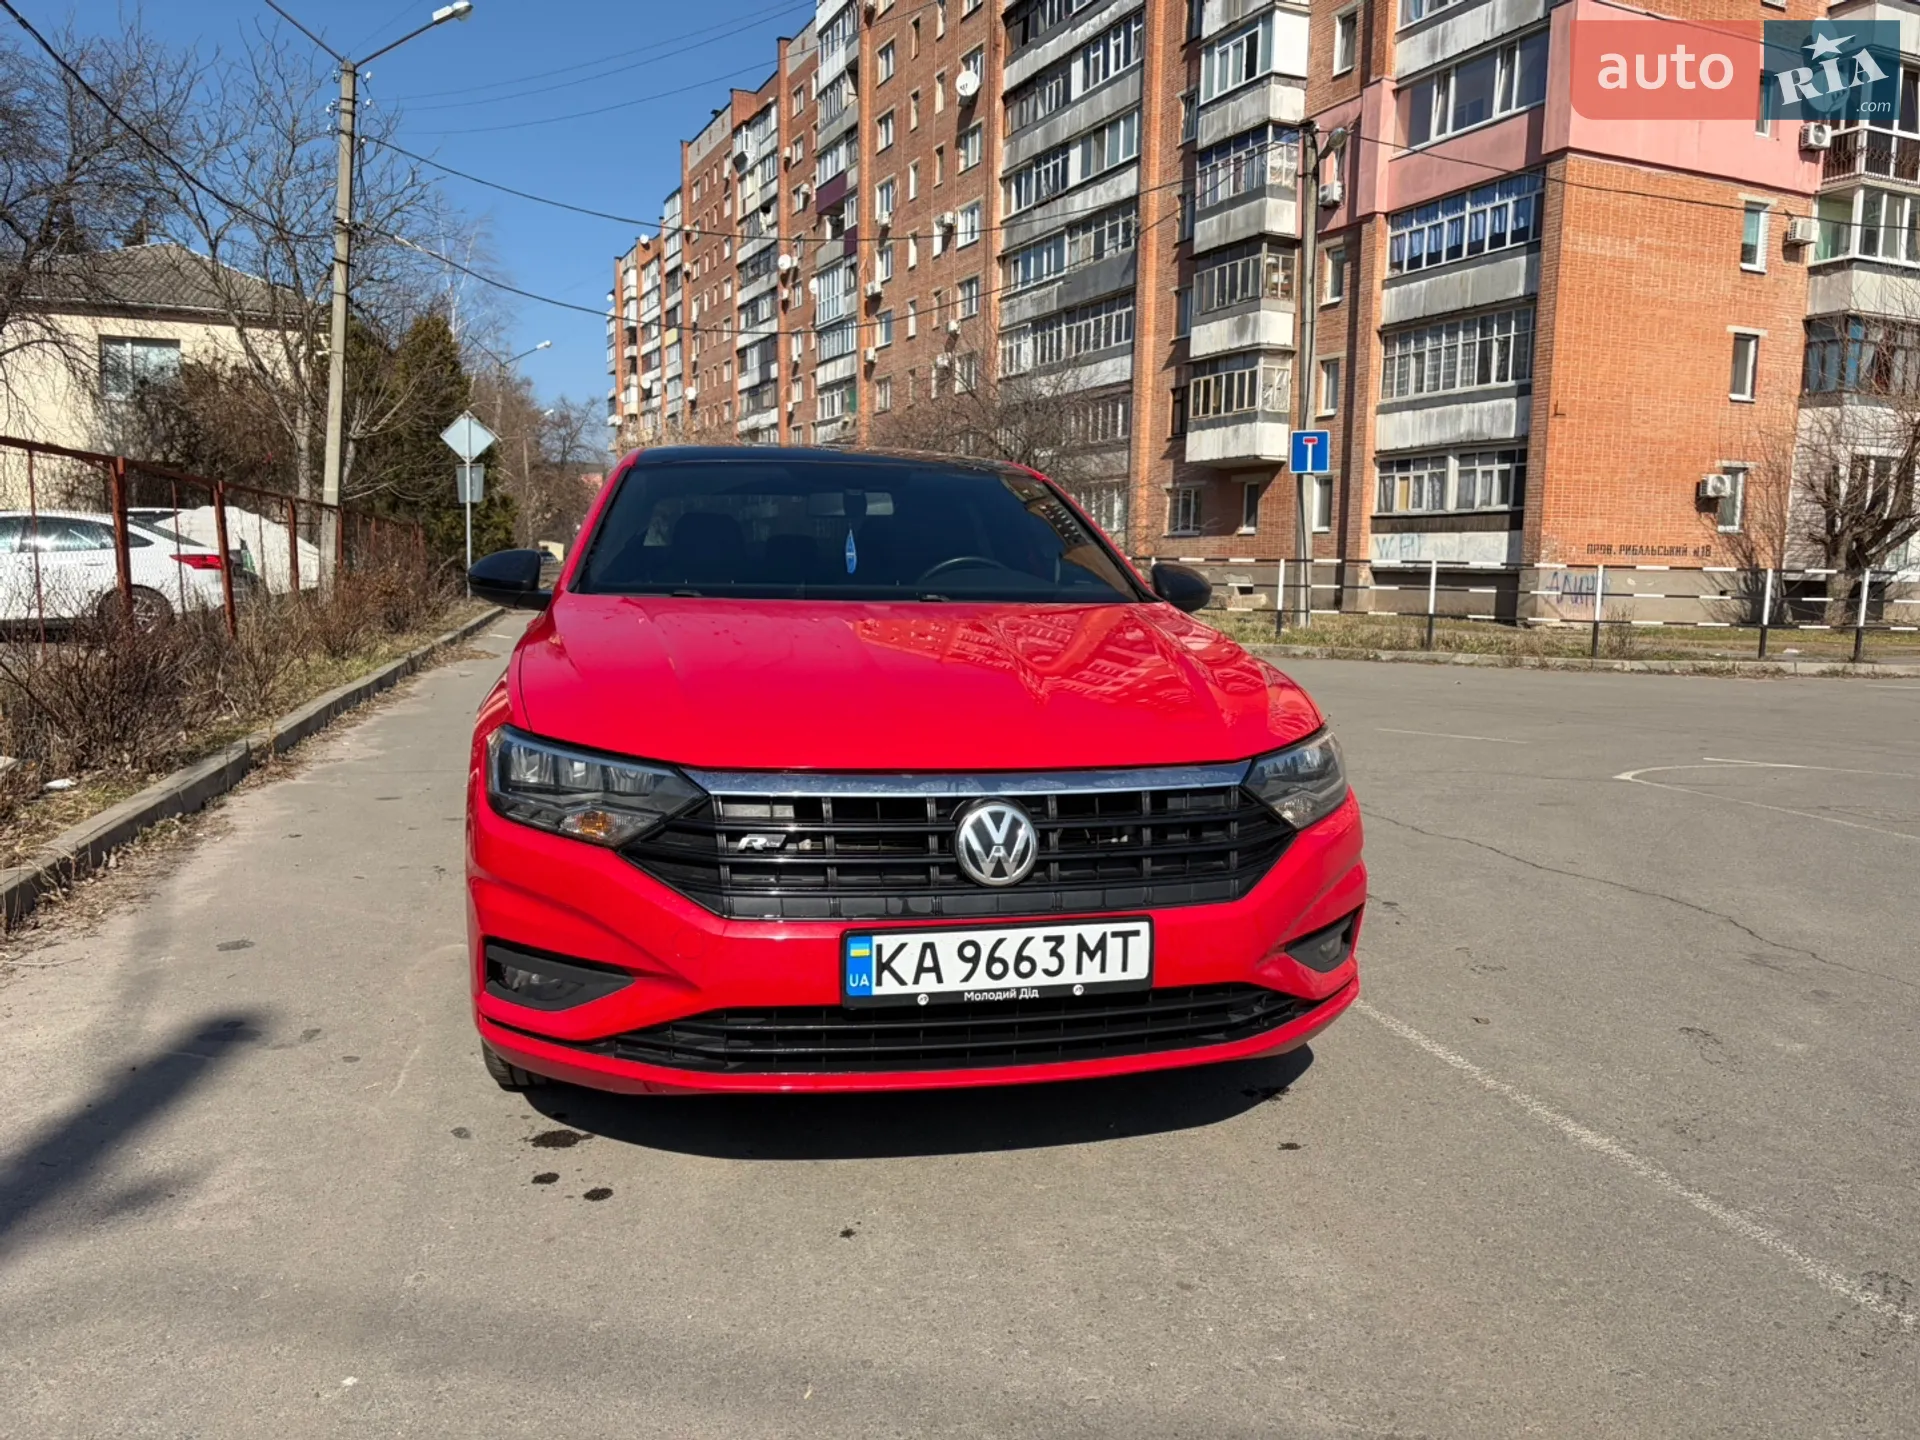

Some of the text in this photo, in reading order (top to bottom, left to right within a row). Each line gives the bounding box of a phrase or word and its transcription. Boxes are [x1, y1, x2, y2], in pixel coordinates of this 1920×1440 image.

[875, 929, 1141, 987] KA 9663 MT
[849, 973, 870, 987] UA
[963, 987, 1040, 1002] Молодий Дід
